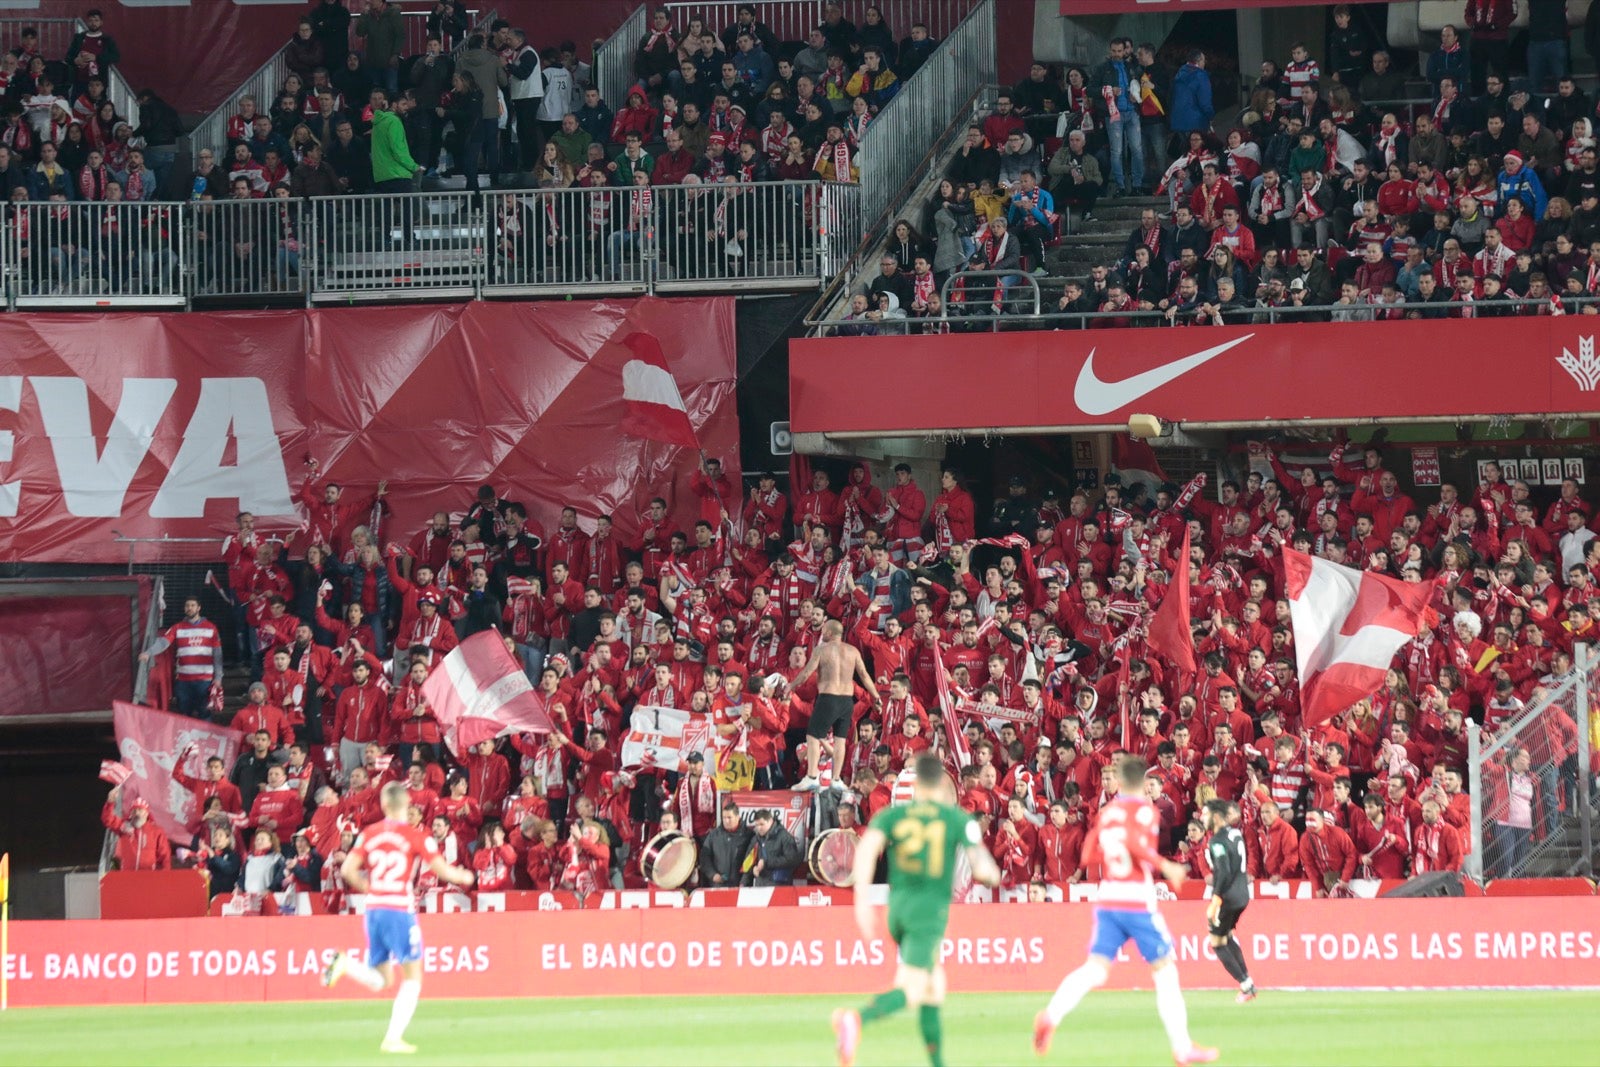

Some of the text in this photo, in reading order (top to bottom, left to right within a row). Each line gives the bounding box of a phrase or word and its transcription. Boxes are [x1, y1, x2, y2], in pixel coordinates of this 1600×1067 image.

[557, 81, 566, 90] 73
[0, 375, 297, 517] VA
[892, 817, 946, 879] 21
[367, 849, 408, 892] 22
[541, 936, 1045, 970] EL BANCO DE TODAS LAS PRESAS
[1253, 933, 1291, 961] DE
[1301, 932, 1399, 961] TODAS
[1411, 931, 1463, 960] LAS
[1475, 931, 1600, 960] EMPRES
[2, 953, 33, 980] EL
[44, 953, 137, 979] BANCO
[146, 951, 179, 978] DE
[188, 949, 277, 976] TODAS
